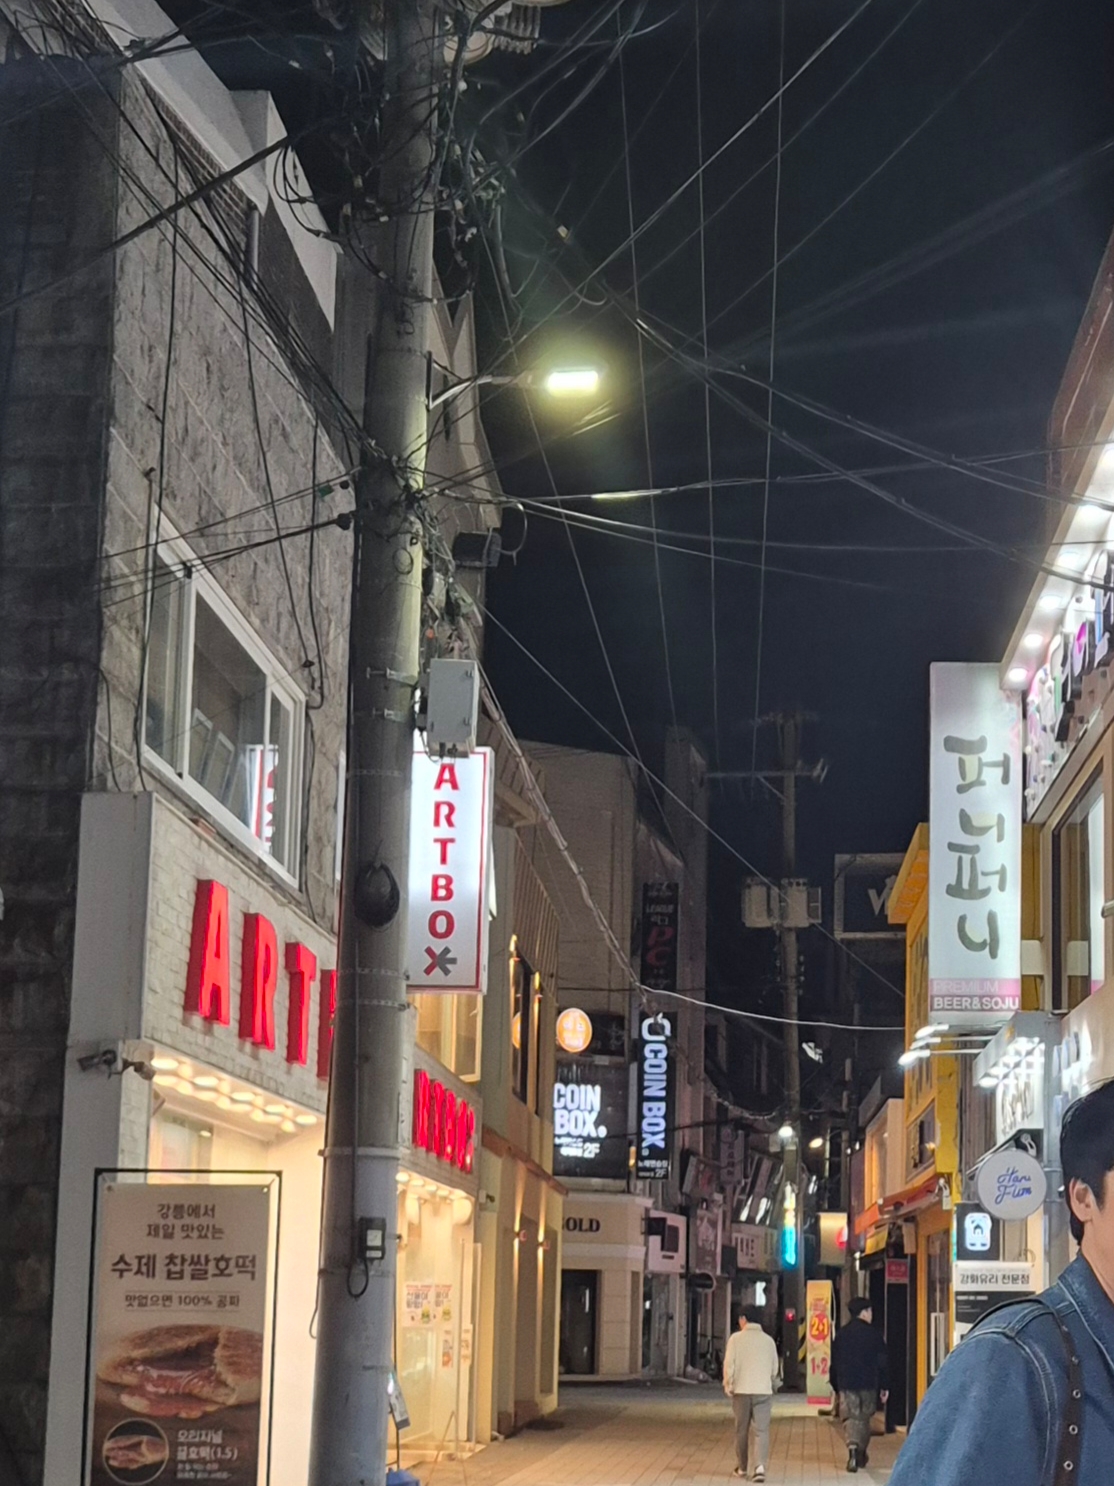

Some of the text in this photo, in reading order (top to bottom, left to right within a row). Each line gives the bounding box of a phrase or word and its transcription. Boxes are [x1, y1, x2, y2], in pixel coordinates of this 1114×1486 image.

[934, 996, 1019, 1010] BEER&SOJU
[644, 1043, 667, 1097] COIN
[554, 1082, 601, 1112] COIN
[157, 1203, 216, 1220] 강릉에서
[146, 1224, 225, 1240] 제일 맛있는
[111, 1253, 256, 1281] 수제 찹쌀호떡
[960, 1273, 1030, 1286] 강화유리 전문점
[125, 1294, 173, 1308] 맛없으면
[178, 1294, 212, 1307] 100%
[177, 1430, 223, 1444] 오리지널
